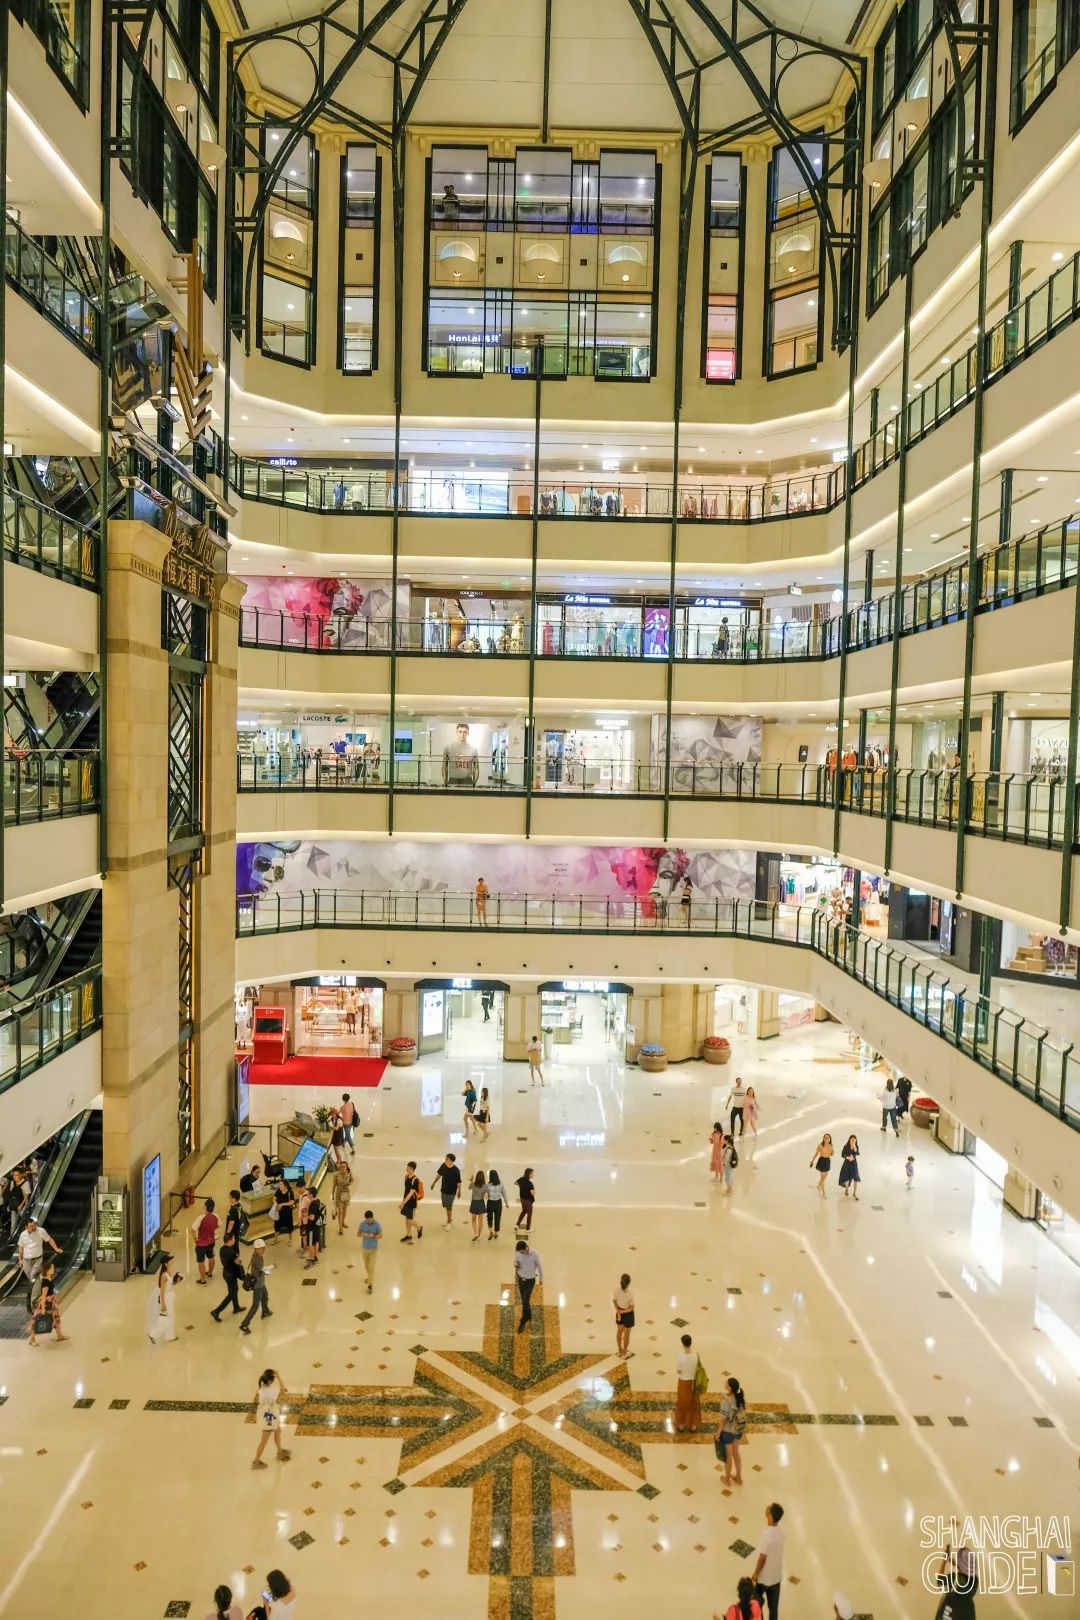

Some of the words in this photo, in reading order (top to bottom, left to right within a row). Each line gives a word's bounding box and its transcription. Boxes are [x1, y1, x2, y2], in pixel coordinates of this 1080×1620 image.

[448, 334, 481, 343] HanLai
[269, 457, 298, 467] callisto
[165, 552, 216, 603] 梅龙镇广场
